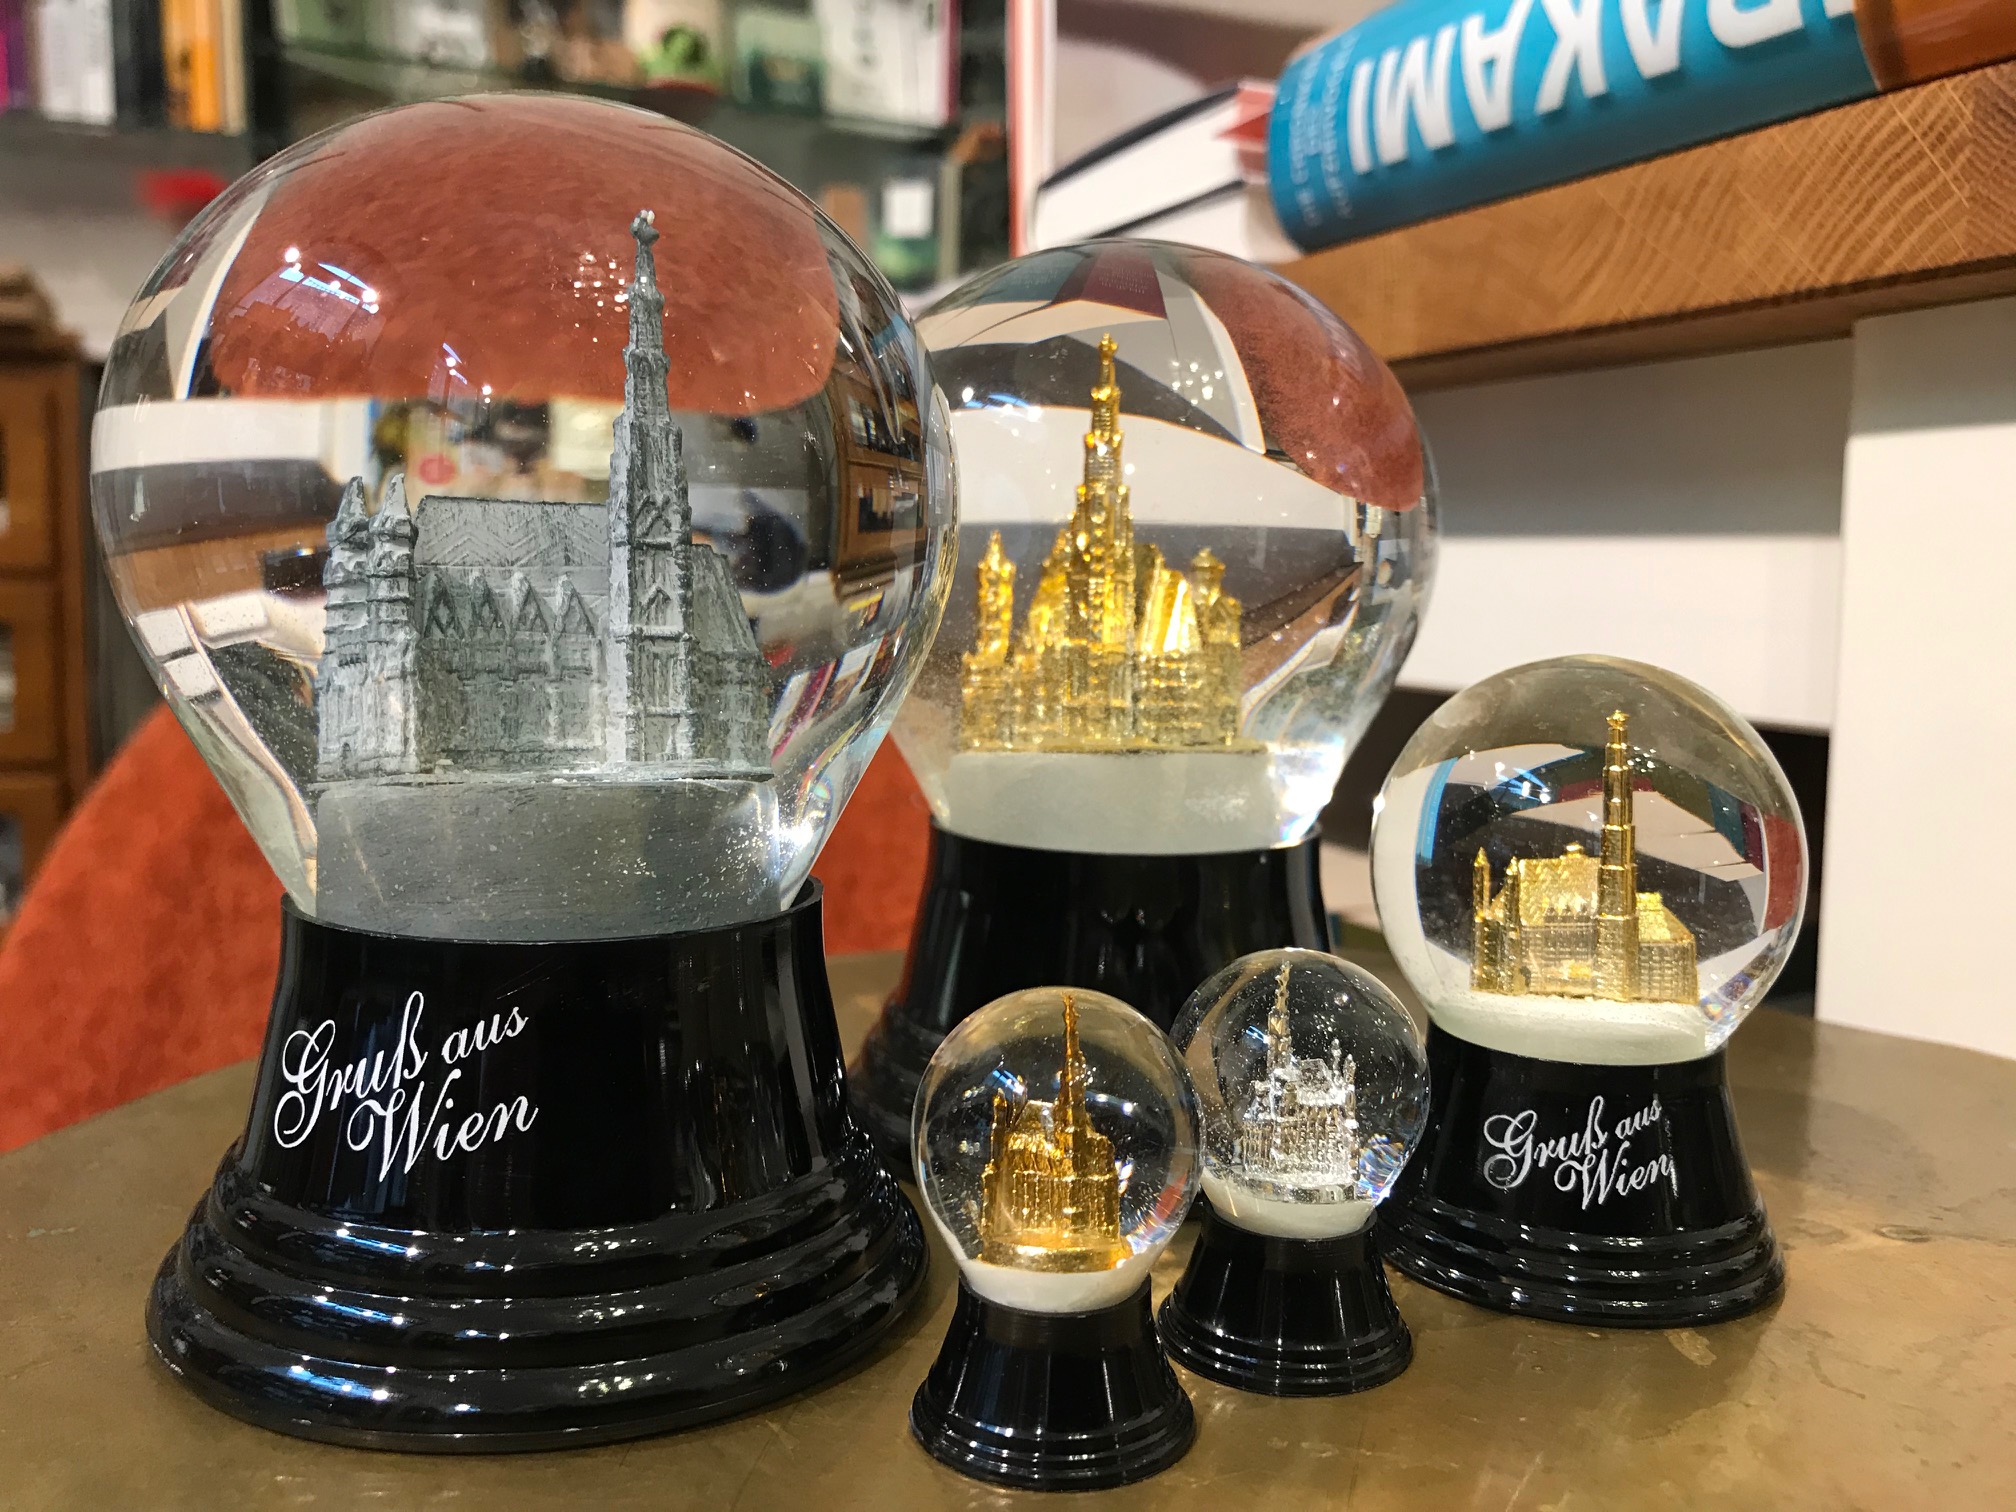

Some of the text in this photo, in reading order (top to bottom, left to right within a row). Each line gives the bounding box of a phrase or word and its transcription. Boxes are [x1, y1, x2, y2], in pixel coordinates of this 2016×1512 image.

[274, 991, 529, 1148] Gruß aus
[347, 1068, 539, 1182] Wien
[1483, 1095, 1662, 1189] Gruß aus
[1554, 1140, 1675, 1210] Wien
